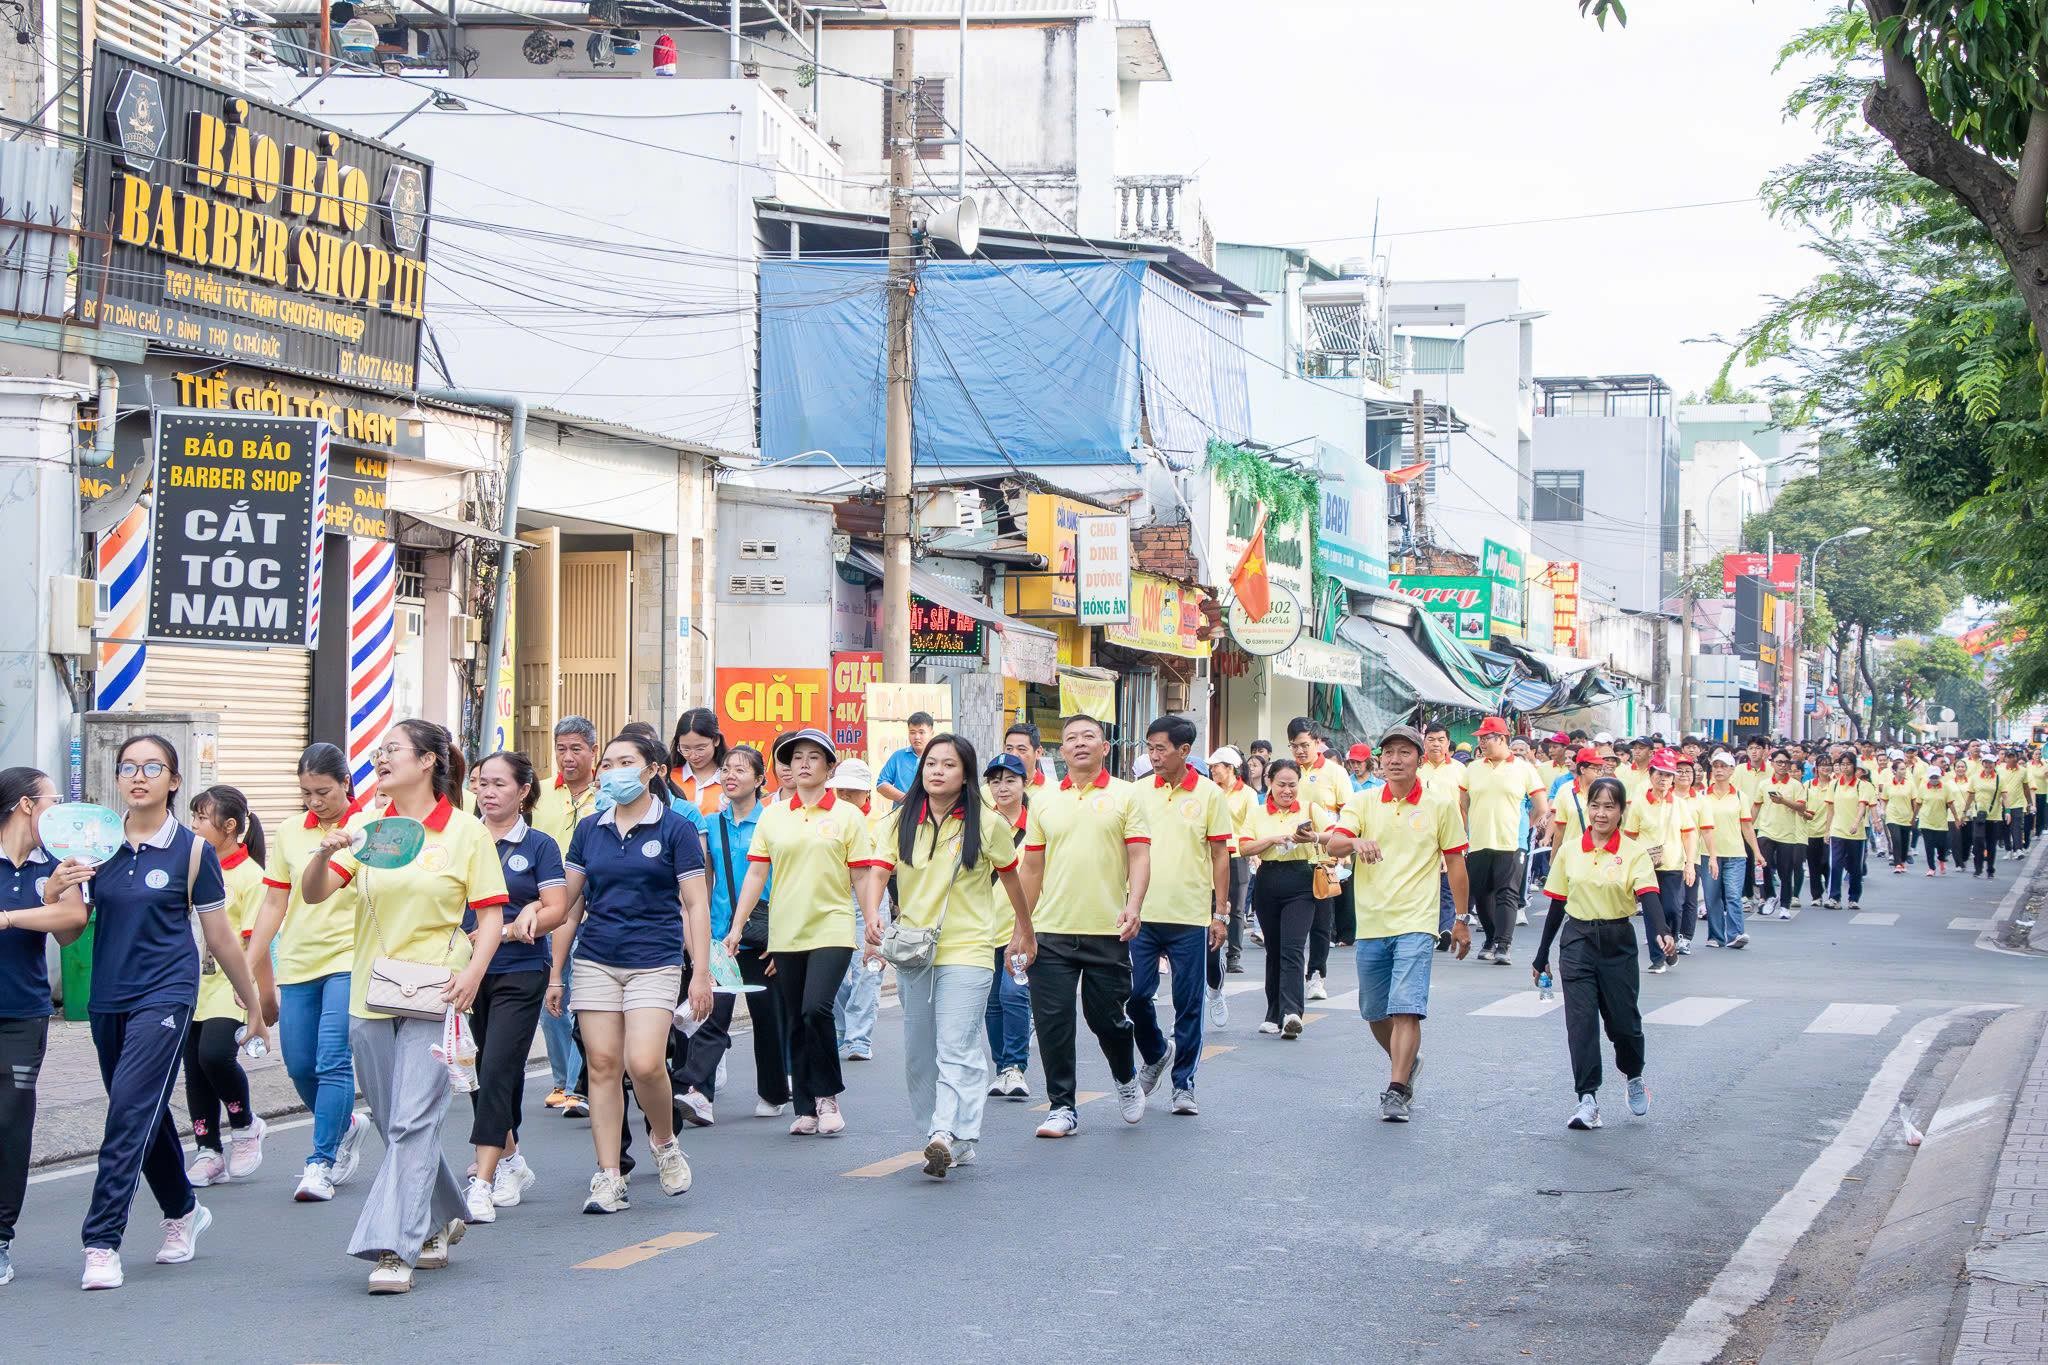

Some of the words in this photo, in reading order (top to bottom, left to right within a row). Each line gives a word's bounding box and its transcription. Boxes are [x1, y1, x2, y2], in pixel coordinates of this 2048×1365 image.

[196, 98, 281, 204] BẢO
[291, 131, 369, 233] BẢO
[118, 172, 288, 285] BARBER
[296, 226, 390, 308] SHOP
[115, 305, 137, 328] DÂN
[178, 316, 201, 342] BÌNH
[166, 269, 192, 299] TẠO
[225, 283, 249, 312] TÓC
[250, 291, 277, 318] NAM
[279, 300, 323, 330] CHUYÊN
[324, 312, 365, 343] NGHIỆP
[176, 368, 230, 409] THẾ
[293, 391, 343, 435] TÓC
[348, 407, 397, 446] NAM
[184, 432, 234, 458] BẢO
[242, 435, 291, 460] BẢO
[170, 465, 245, 491] BARBER
[251, 469, 302, 493] SHOP
[355, 456, 387, 479] KHU
[354, 485, 386, 510] ĐÀN
[1325, 491, 1350, 537] BABY
[184, 499, 286, 545] CẮT
[352, 512, 386, 538] ÔNG
[181, 550, 281, 590] TÓC
[169, 593, 288, 629] NAM
[724, 674, 819, 732] GIẶT
[836, 702, 867, 725] 4K/
